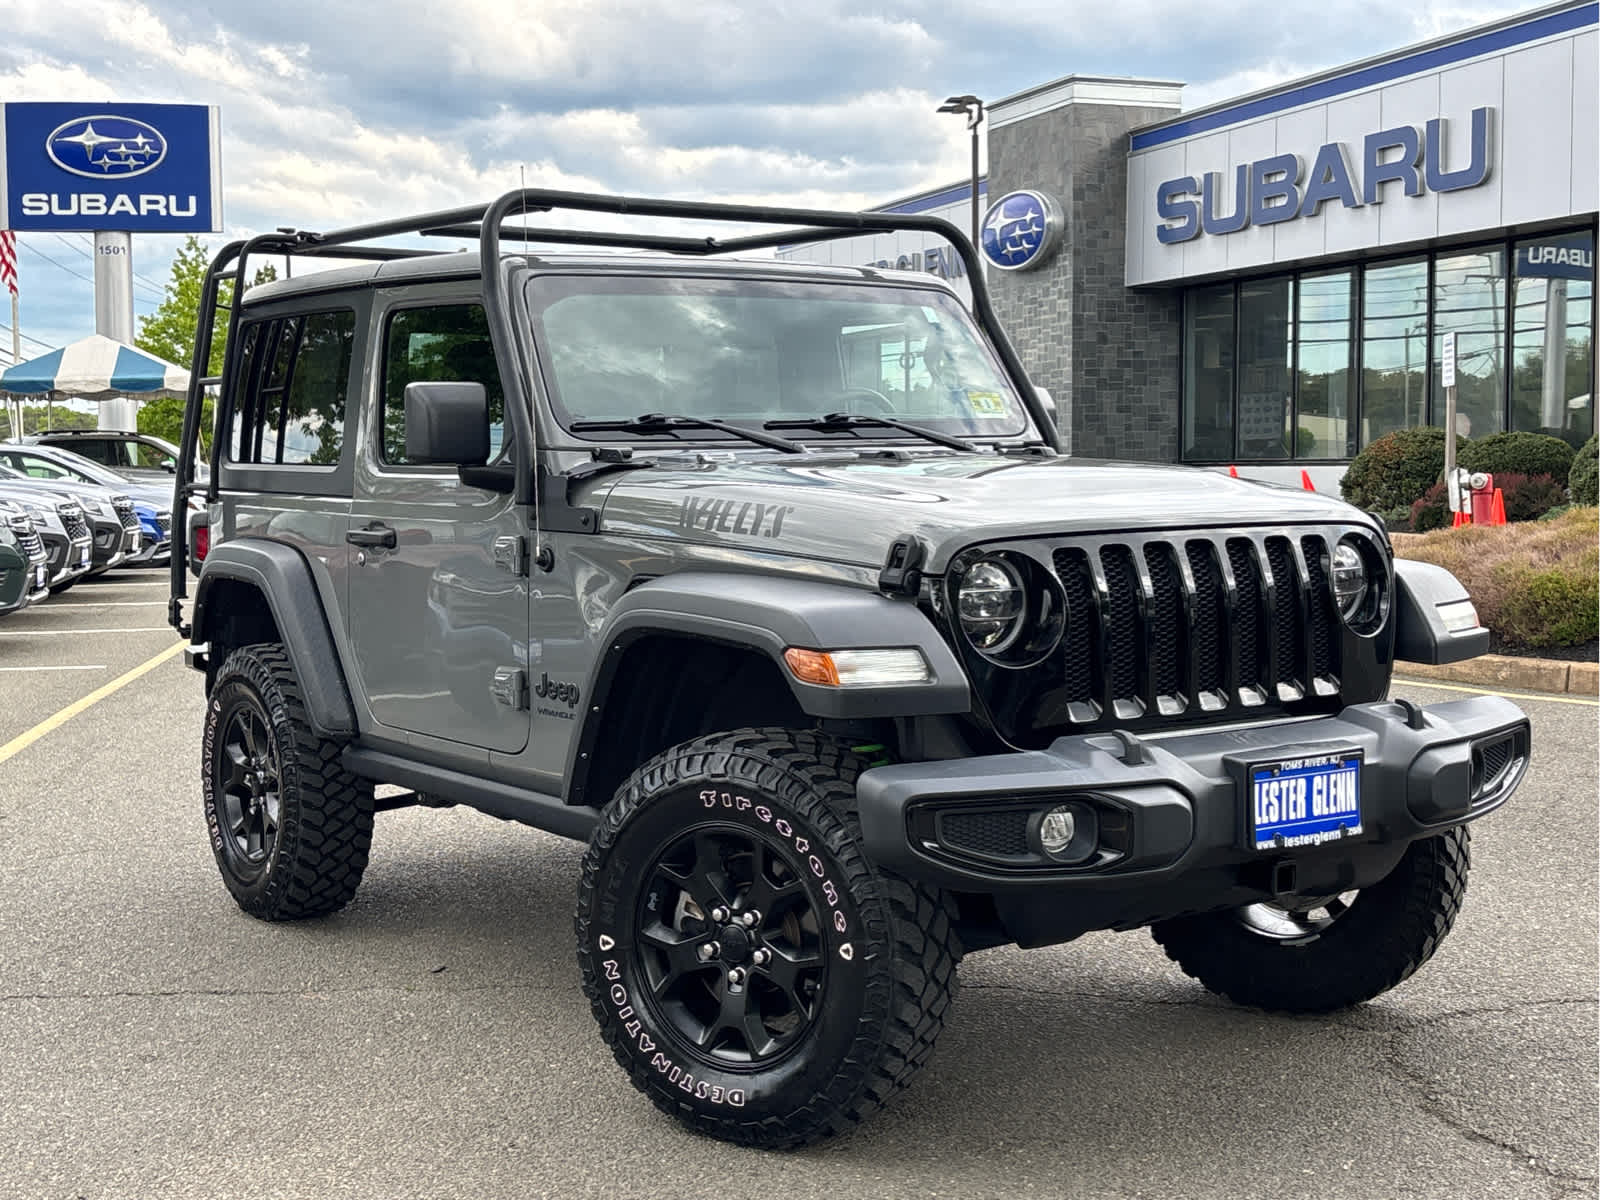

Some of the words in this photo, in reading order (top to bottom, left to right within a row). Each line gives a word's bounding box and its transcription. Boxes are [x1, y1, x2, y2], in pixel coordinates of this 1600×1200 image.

[1156, 106, 1494, 244] SUBARU
[22, 193, 197, 216] SUBARU
[98, 245, 126, 255] 1501
[680, 496, 794, 538] WILLYS
[535, 672, 580, 709] Jeep
[1254, 777, 1306, 825] LESTER
[1312, 771, 1357, 816] GLENN
[700, 790, 847, 933] Firestone
[603, 960, 745, 1107] DESTINATION
